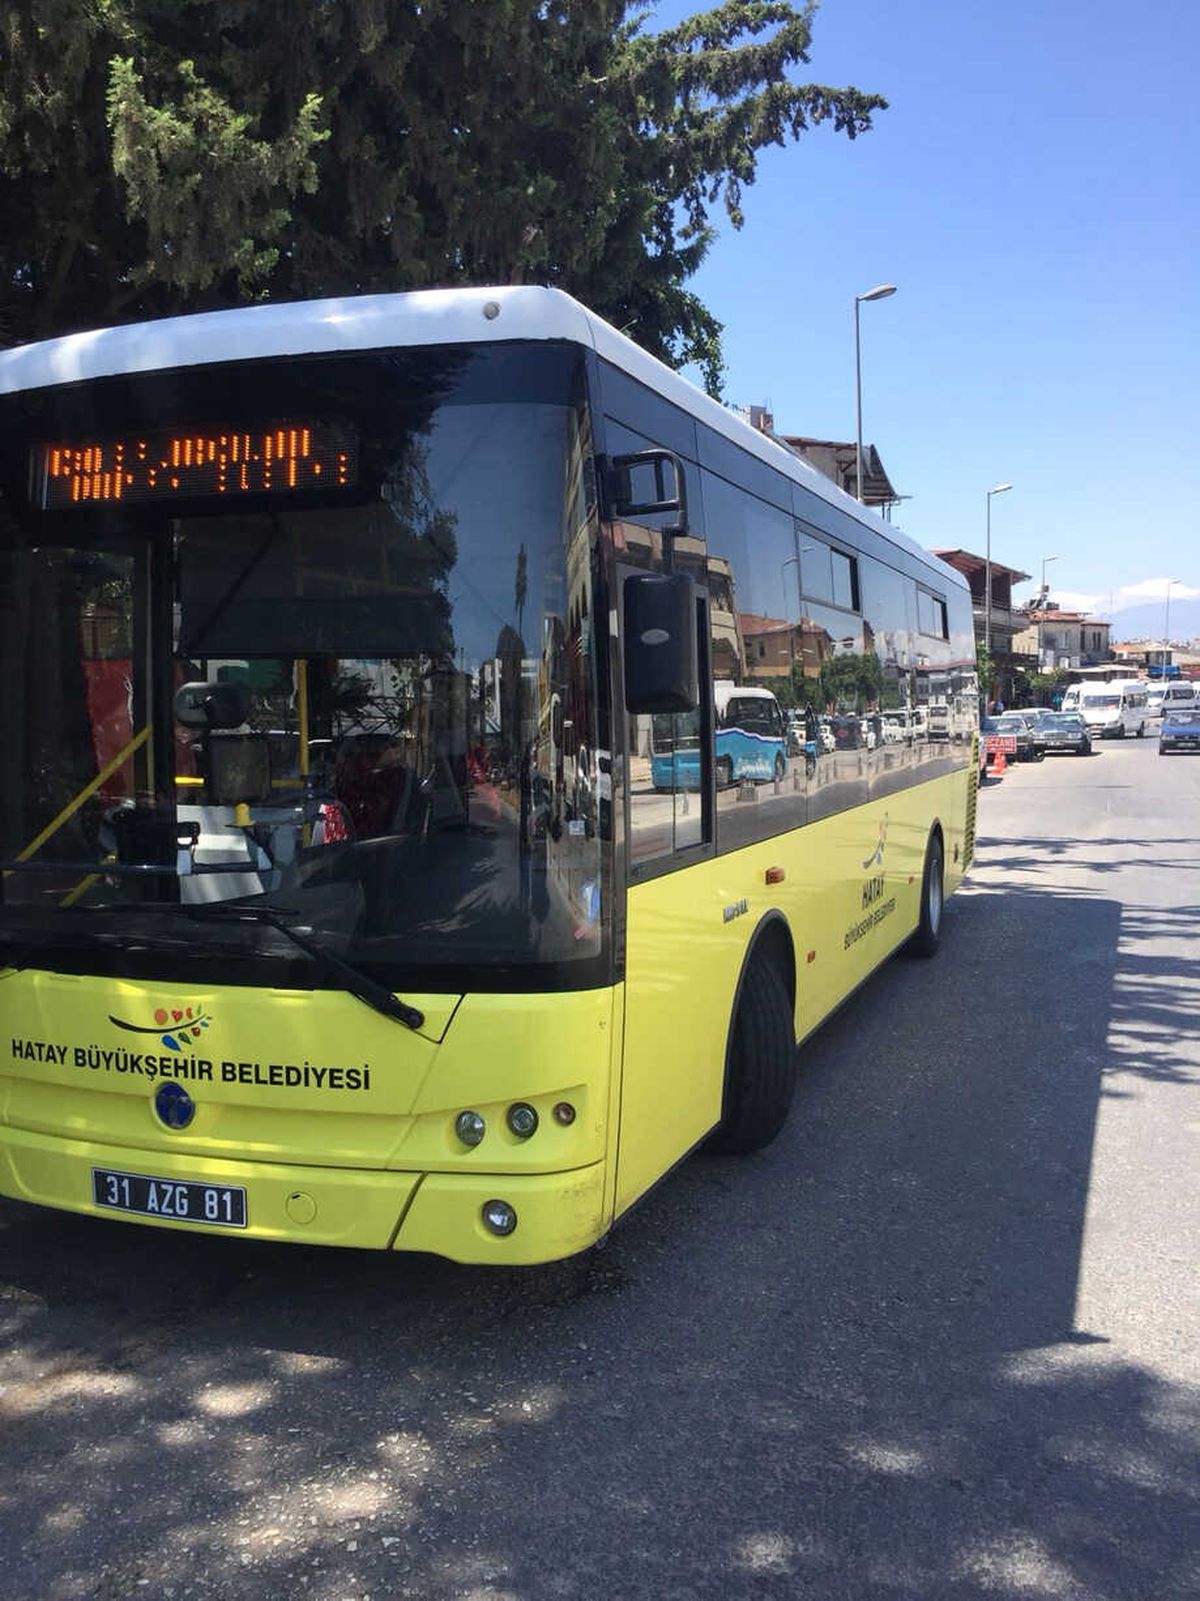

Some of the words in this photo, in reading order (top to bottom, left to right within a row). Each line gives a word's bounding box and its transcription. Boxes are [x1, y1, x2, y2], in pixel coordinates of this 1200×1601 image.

[11, 1038, 68, 1066] HATAY
[74, 1047, 213, 1081] BÜYÜKŞEHİR
[221, 1062, 371, 1091] BELEDİYESİ
[106, 1175, 130, 1207] 31
[147, 1183, 189, 1216] AZG
[204, 1189, 233, 1222] 81
